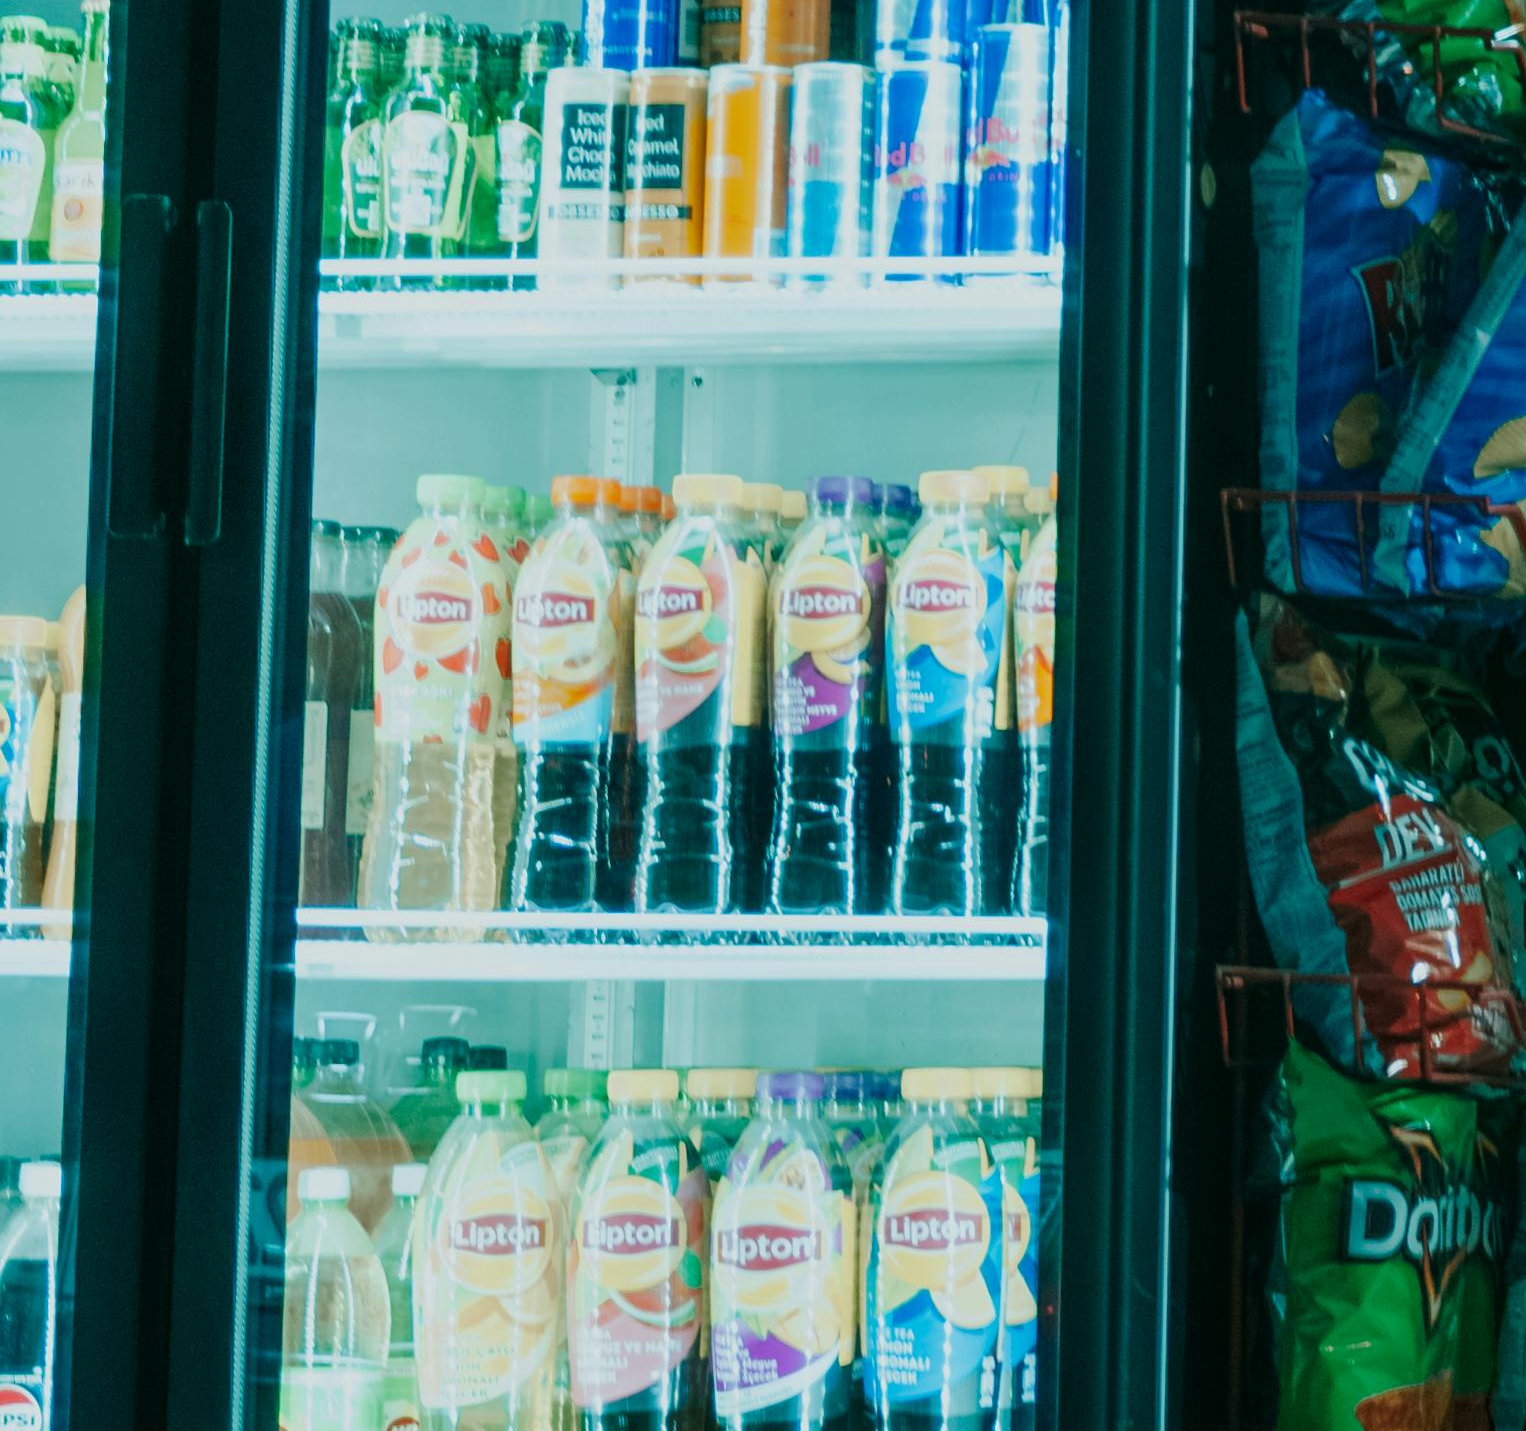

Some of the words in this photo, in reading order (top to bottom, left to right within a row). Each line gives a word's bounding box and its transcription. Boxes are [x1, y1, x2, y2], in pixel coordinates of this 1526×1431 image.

[781, 585, 858, 619] Lipton
[898, 581, 974, 612] Lipton
[1373, 807, 1453, 871] DEV
[453, 1217, 540, 1249] Lipton
[585, 1217, 672, 1248] Lipton
[889, 1212, 978, 1245] Lipton
[721, 1229, 818, 1268] Lipton
